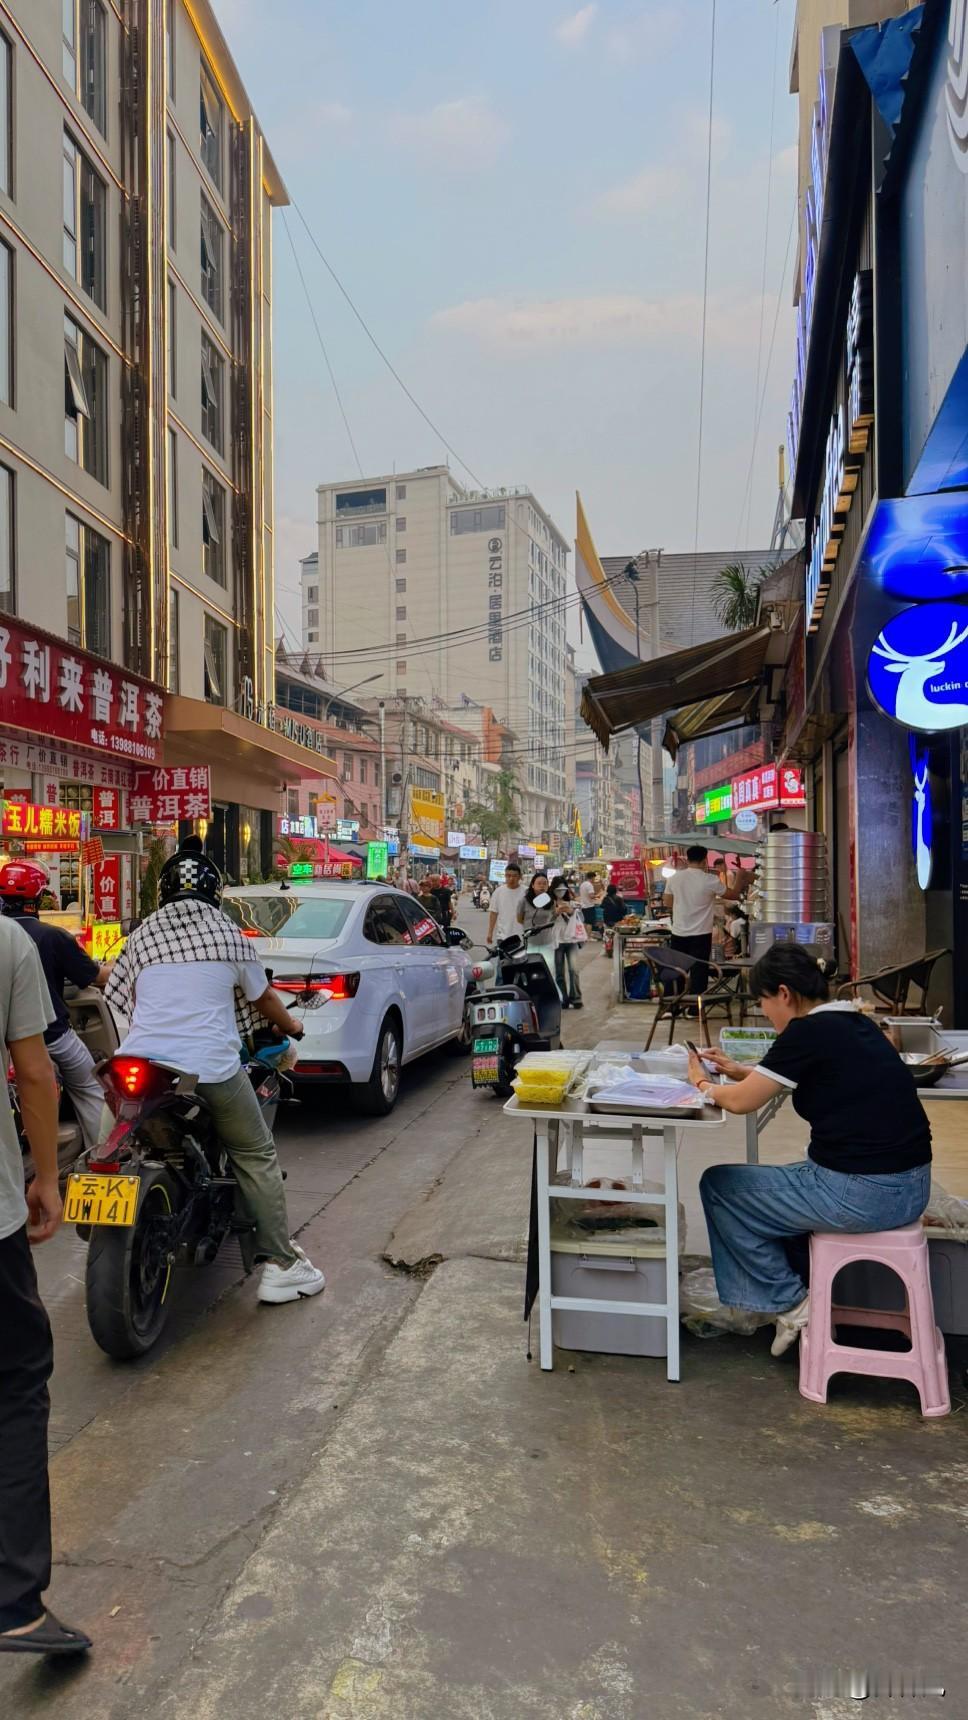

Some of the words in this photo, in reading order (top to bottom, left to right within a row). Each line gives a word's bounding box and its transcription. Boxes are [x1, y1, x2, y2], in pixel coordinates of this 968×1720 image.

[930, 681, 961, 693] luckin
[133, 767, 208, 791] 厂价直销
[99, 790, 116, 827] 普洱
[130, 793, 208, 821] 普洱茶
[292, 863, 313, 875] 空车
[68, 1199, 128, 1223] UW141
